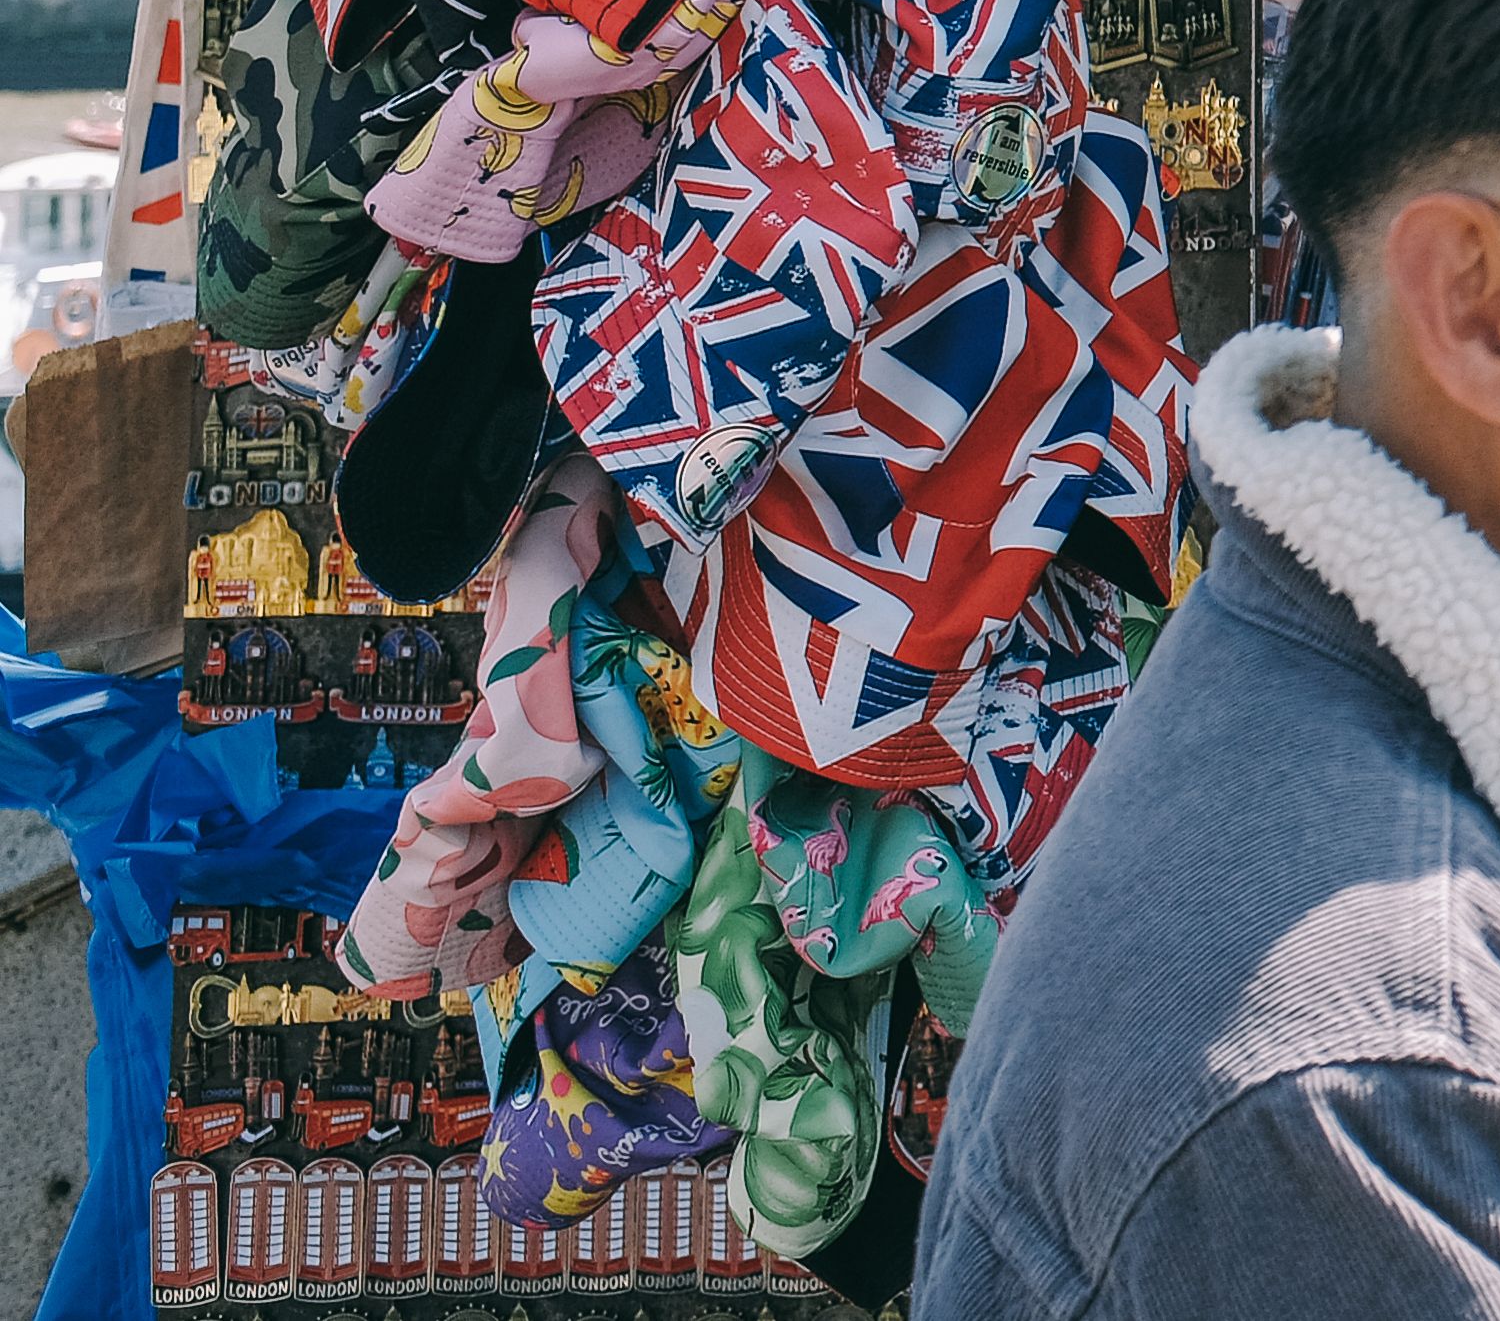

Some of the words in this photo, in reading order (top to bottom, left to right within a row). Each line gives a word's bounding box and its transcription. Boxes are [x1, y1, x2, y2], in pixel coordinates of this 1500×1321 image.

[999, 135, 1021, 153] am
[962, 147, 1031, 180] reversible
[361, 707, 442, 722] LONDON
[154, 1285, 216, 1304] LONDON
[228, 1282, 289, 1300] LONDON
[297, 1280, 358, 1298] LONDON
